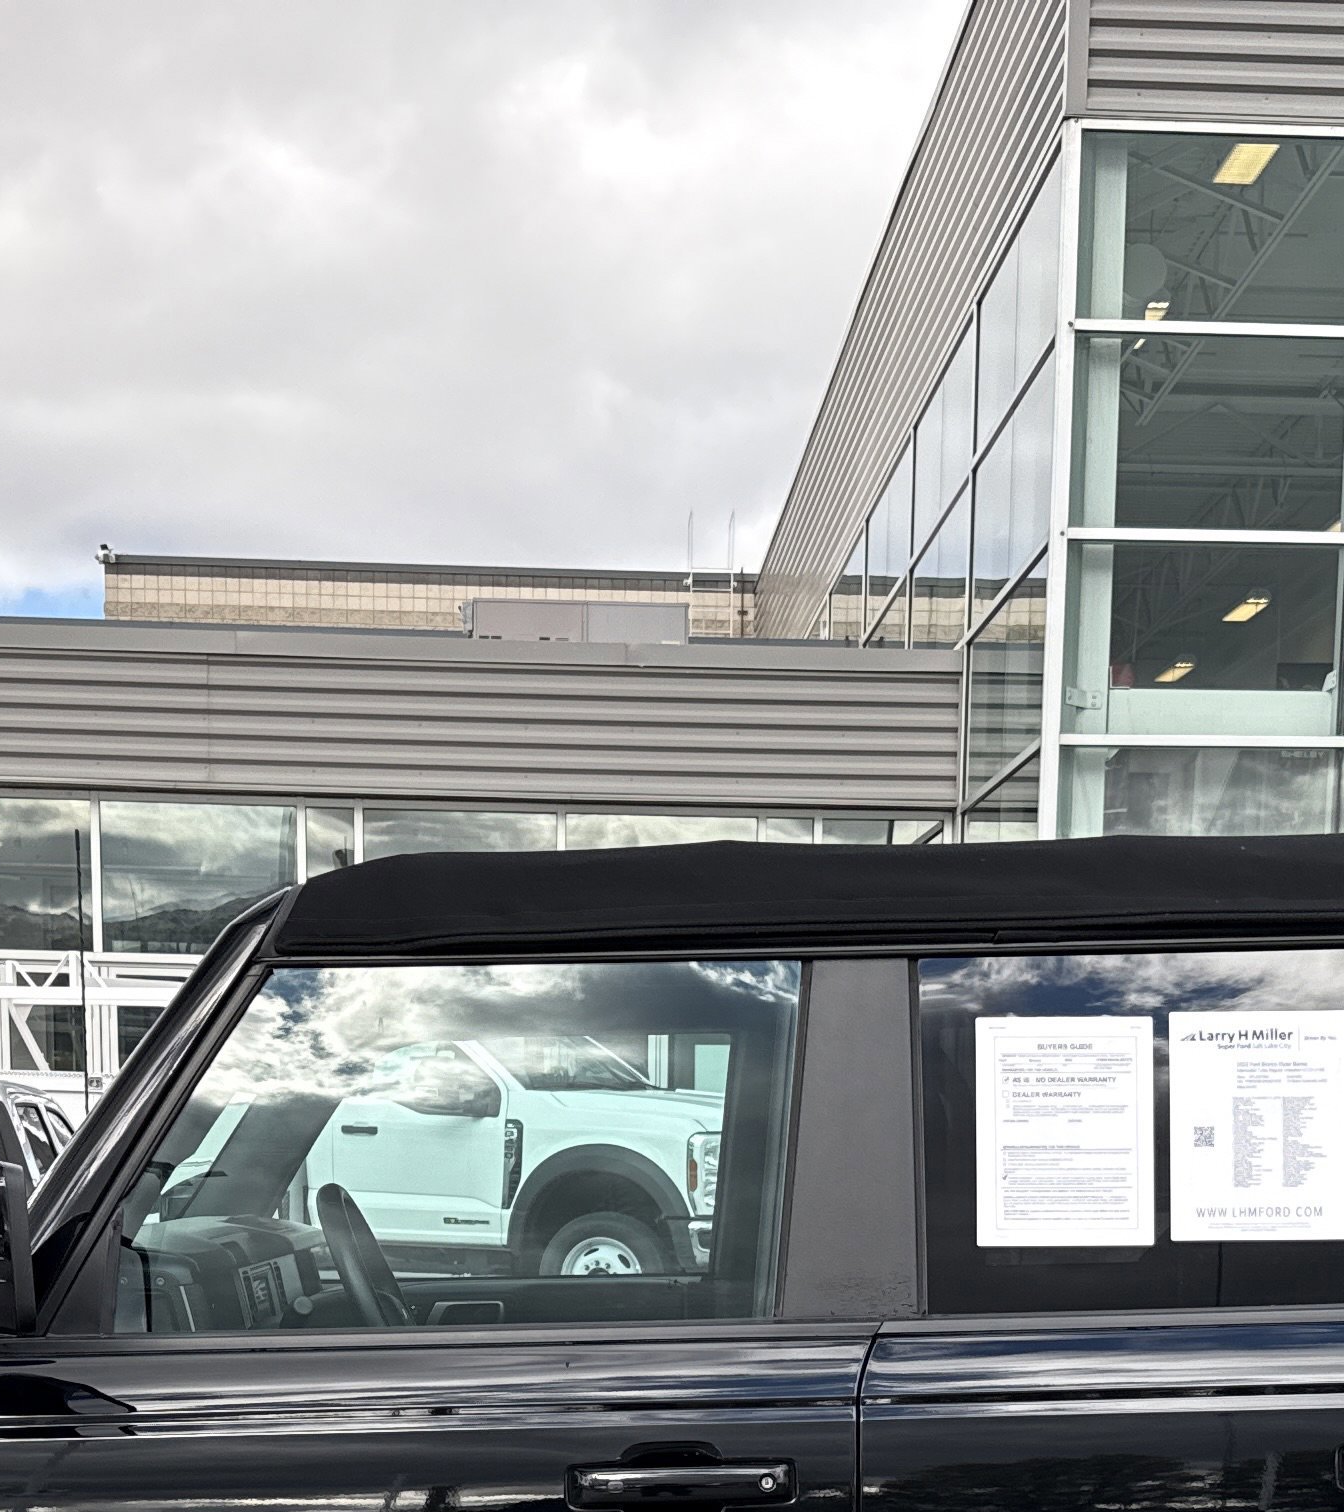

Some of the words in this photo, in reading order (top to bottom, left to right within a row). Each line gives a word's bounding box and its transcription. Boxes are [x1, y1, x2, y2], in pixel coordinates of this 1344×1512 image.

[1281, 750, 1325, 758] SHELBY
[1199, 1030, 1235, 1043] Larry
[1238, 1030, 1248, 1041] H
[1252, 1027, 1294, 1041] Miller
[1217, 1042, 1235, 1050] Super
